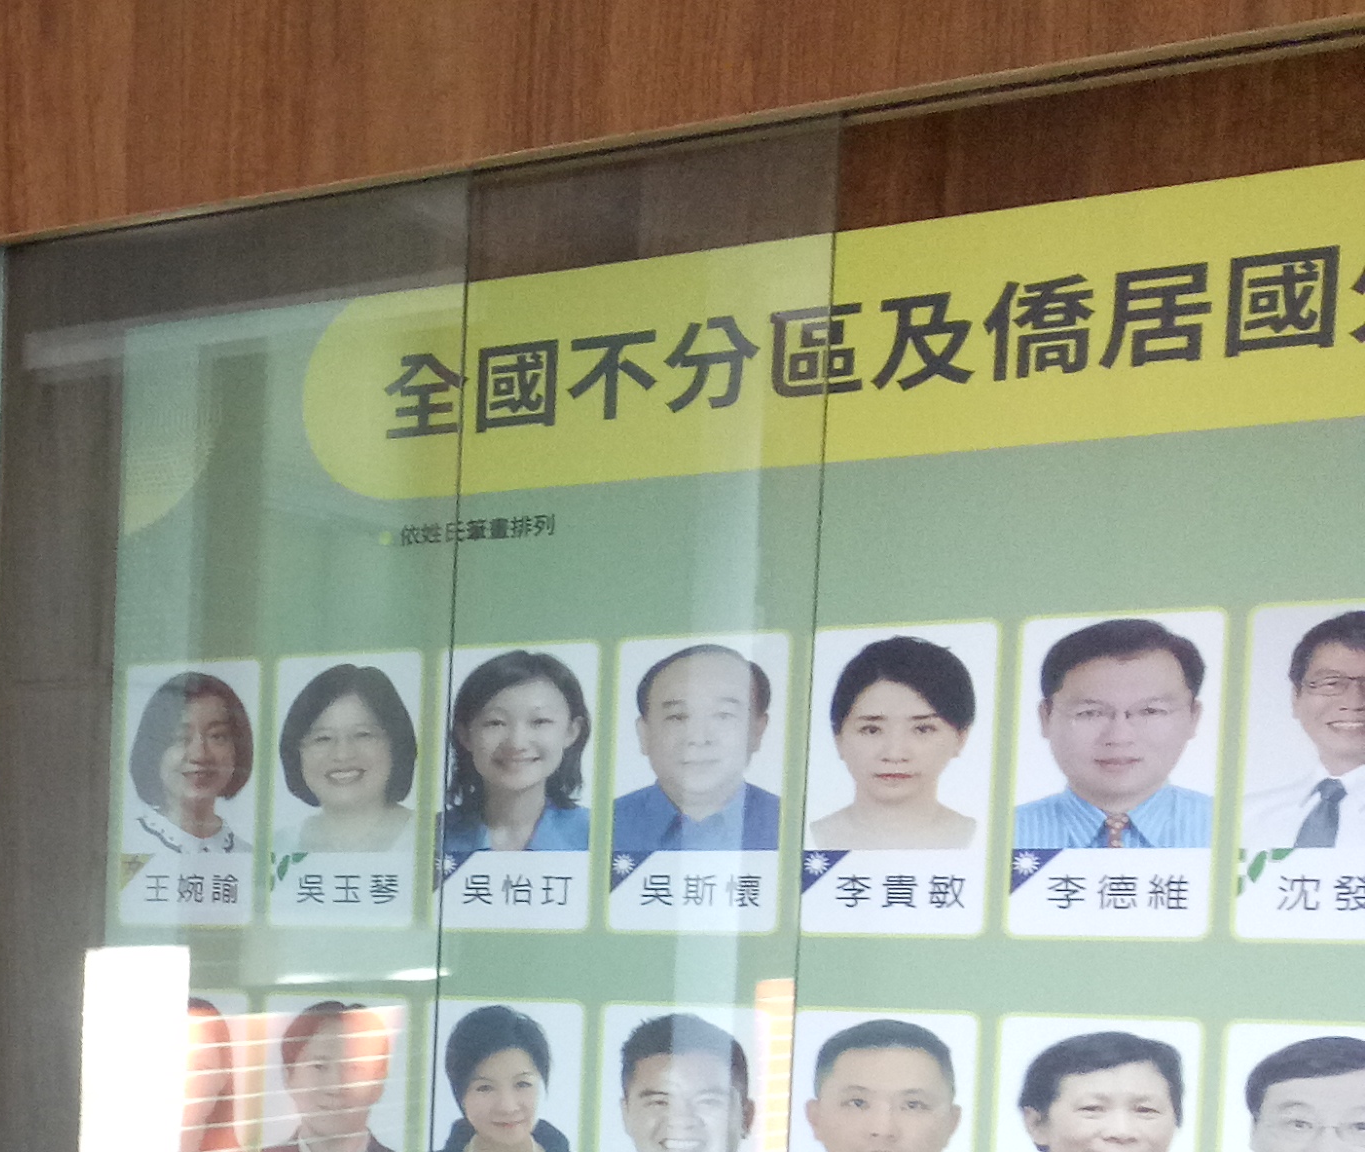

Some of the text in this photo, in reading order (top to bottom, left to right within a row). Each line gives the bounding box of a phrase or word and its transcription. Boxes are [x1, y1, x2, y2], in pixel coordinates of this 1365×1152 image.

[385, 244, 1365, 440] 全國不分區及僑居國
[145, 873, 239, 904] 王婉諭
[296, 873, 401, 905] 吳玉琴
[462, 873, 574, 906] 吳怡玎
[640, 873, 762, 909] 吳斯懷
[835, 873, 967, 910] 李貴敏
[1046, 873, 1190, 912] 李德維
